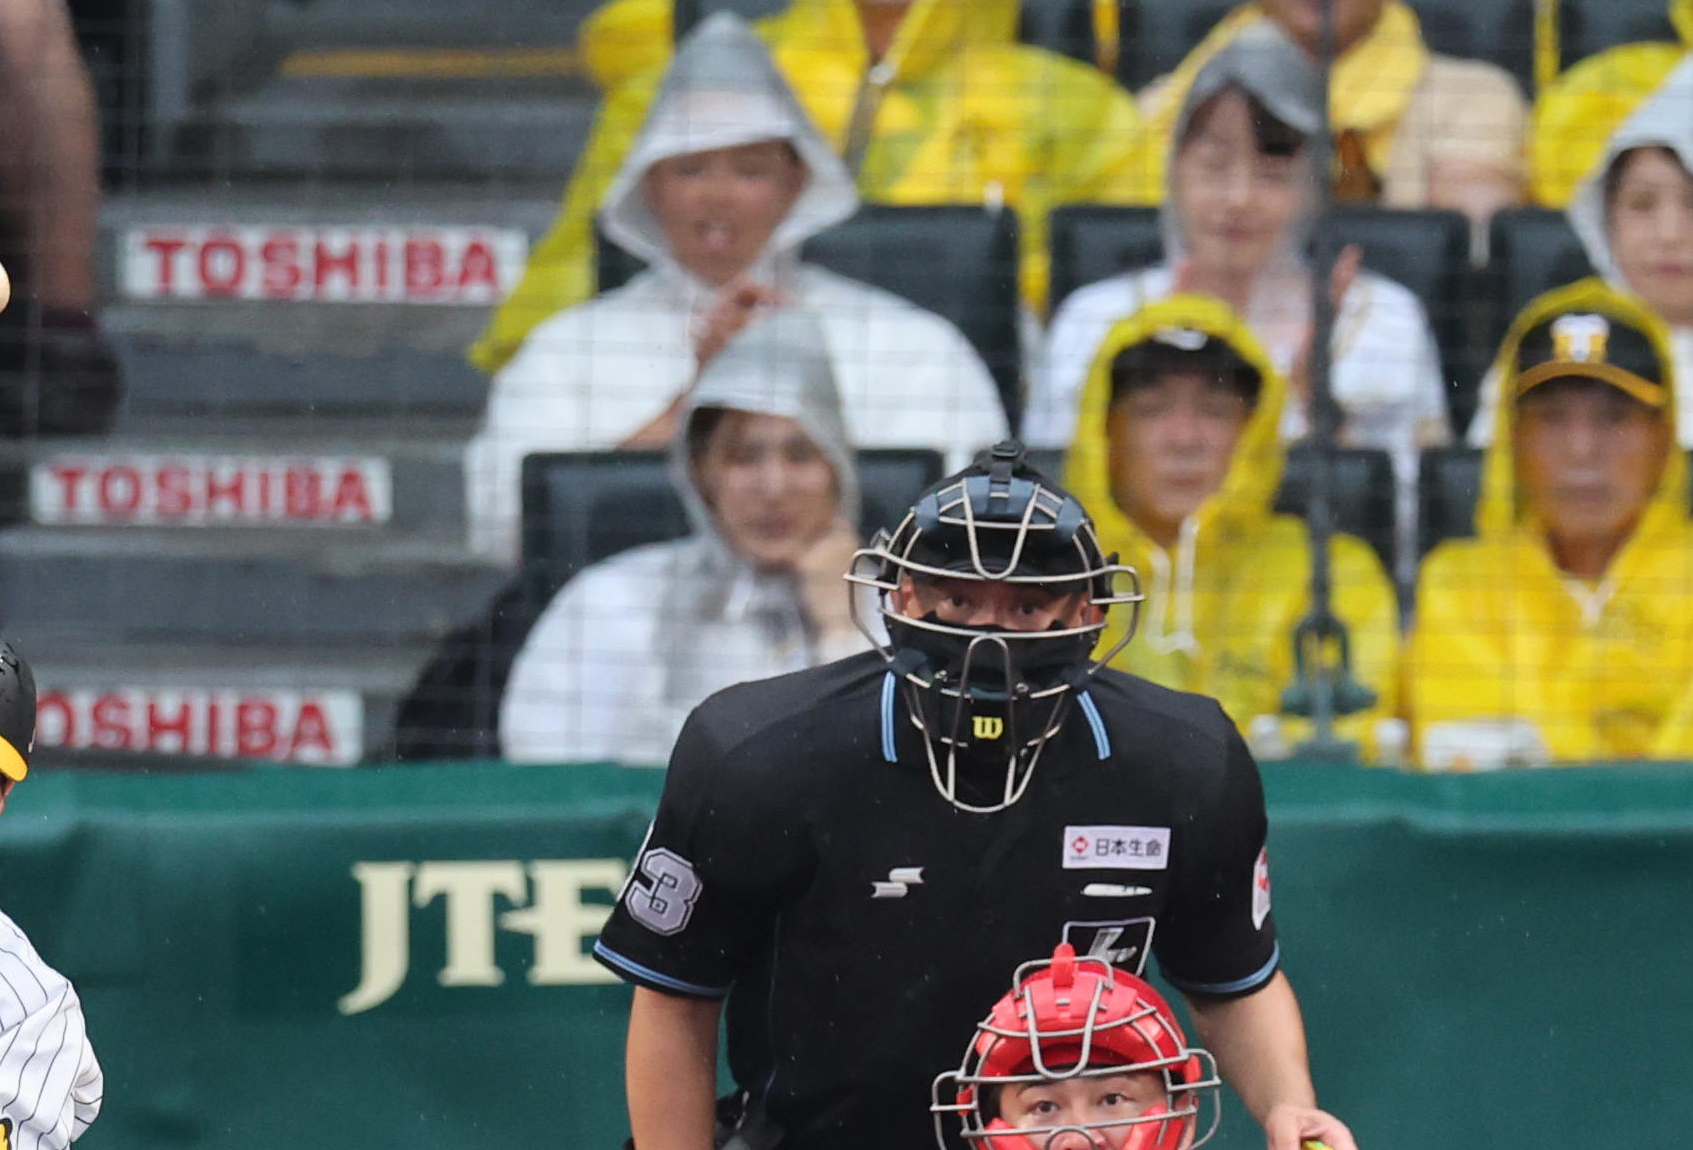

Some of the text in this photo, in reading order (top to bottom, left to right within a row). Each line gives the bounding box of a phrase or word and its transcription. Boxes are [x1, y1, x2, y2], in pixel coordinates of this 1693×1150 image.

[145, 235, 501, 294] TOSHIBA
[52, 464, 375, 520] TOSHIBA
[1095, 838, 1162, 858] 日本生命
[619, 826, 704, 937] 3
